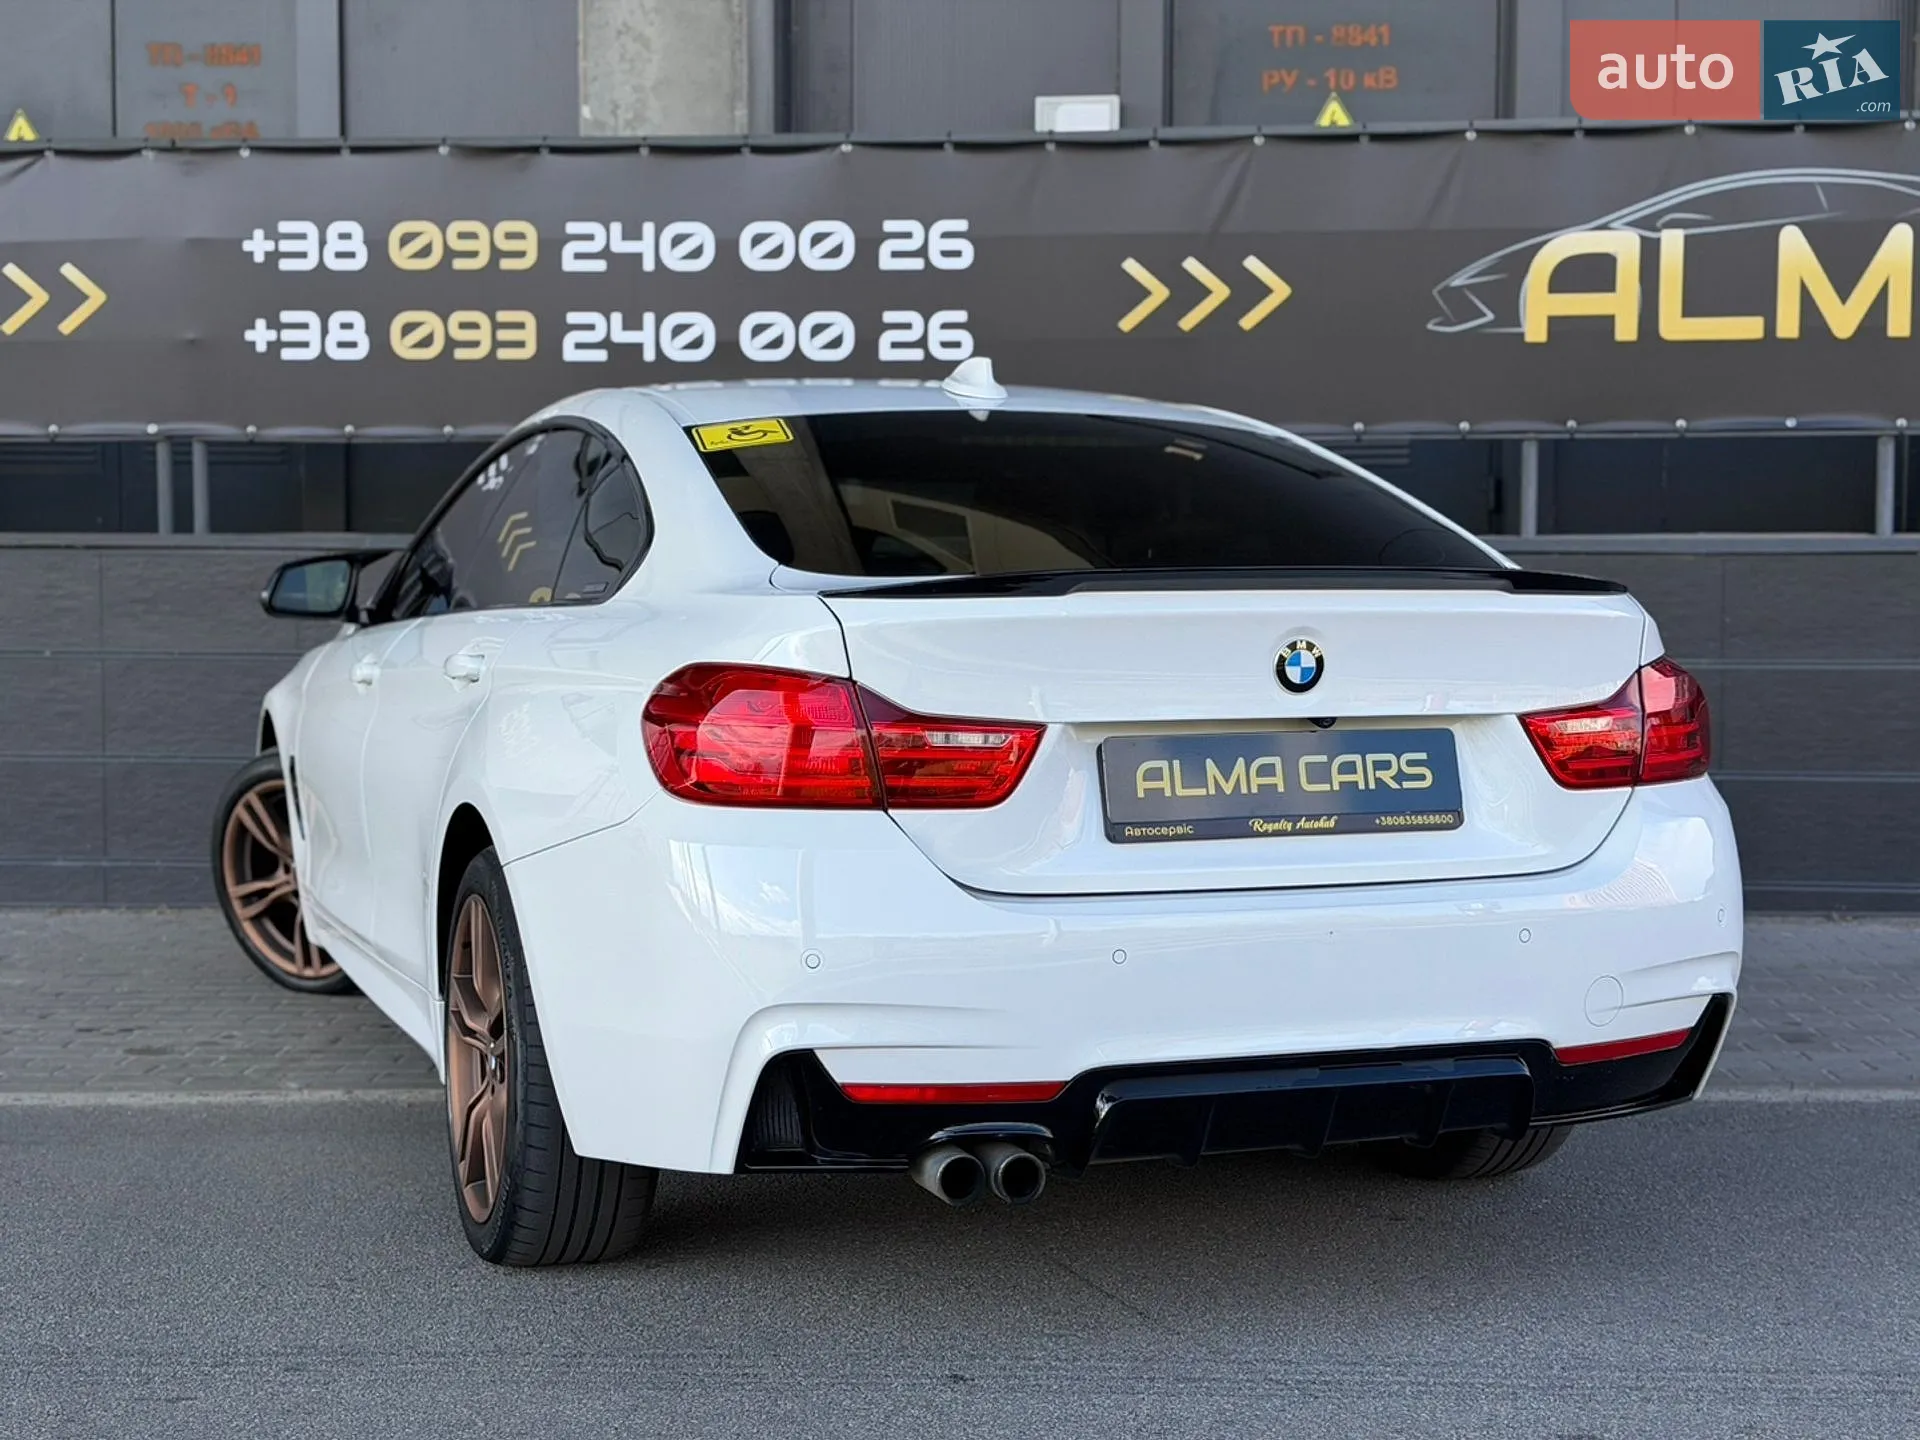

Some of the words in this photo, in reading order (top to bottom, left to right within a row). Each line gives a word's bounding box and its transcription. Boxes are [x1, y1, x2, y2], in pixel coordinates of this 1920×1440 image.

[1324, 68, 1355, 91] 10
[242, 220, 368, 271] +38
[388, 220, 538, 271] 099
[561, 221, 716, 272] 240
[739, 220, 856, 271] 00
[878, 219, 975, 270] 26
[244, 310, 370, 360] +38
[389, 310, 537, 360] 093
[562, 311, 716, 362] 240
[739, 311, 856, 362] 00
[878, 310, 974, 361] 26
[1281, 640, 1322, 658] BMW
[1136, 756, 1284, 798] ALMA
[1299, 752, 1433, 792] CARS
